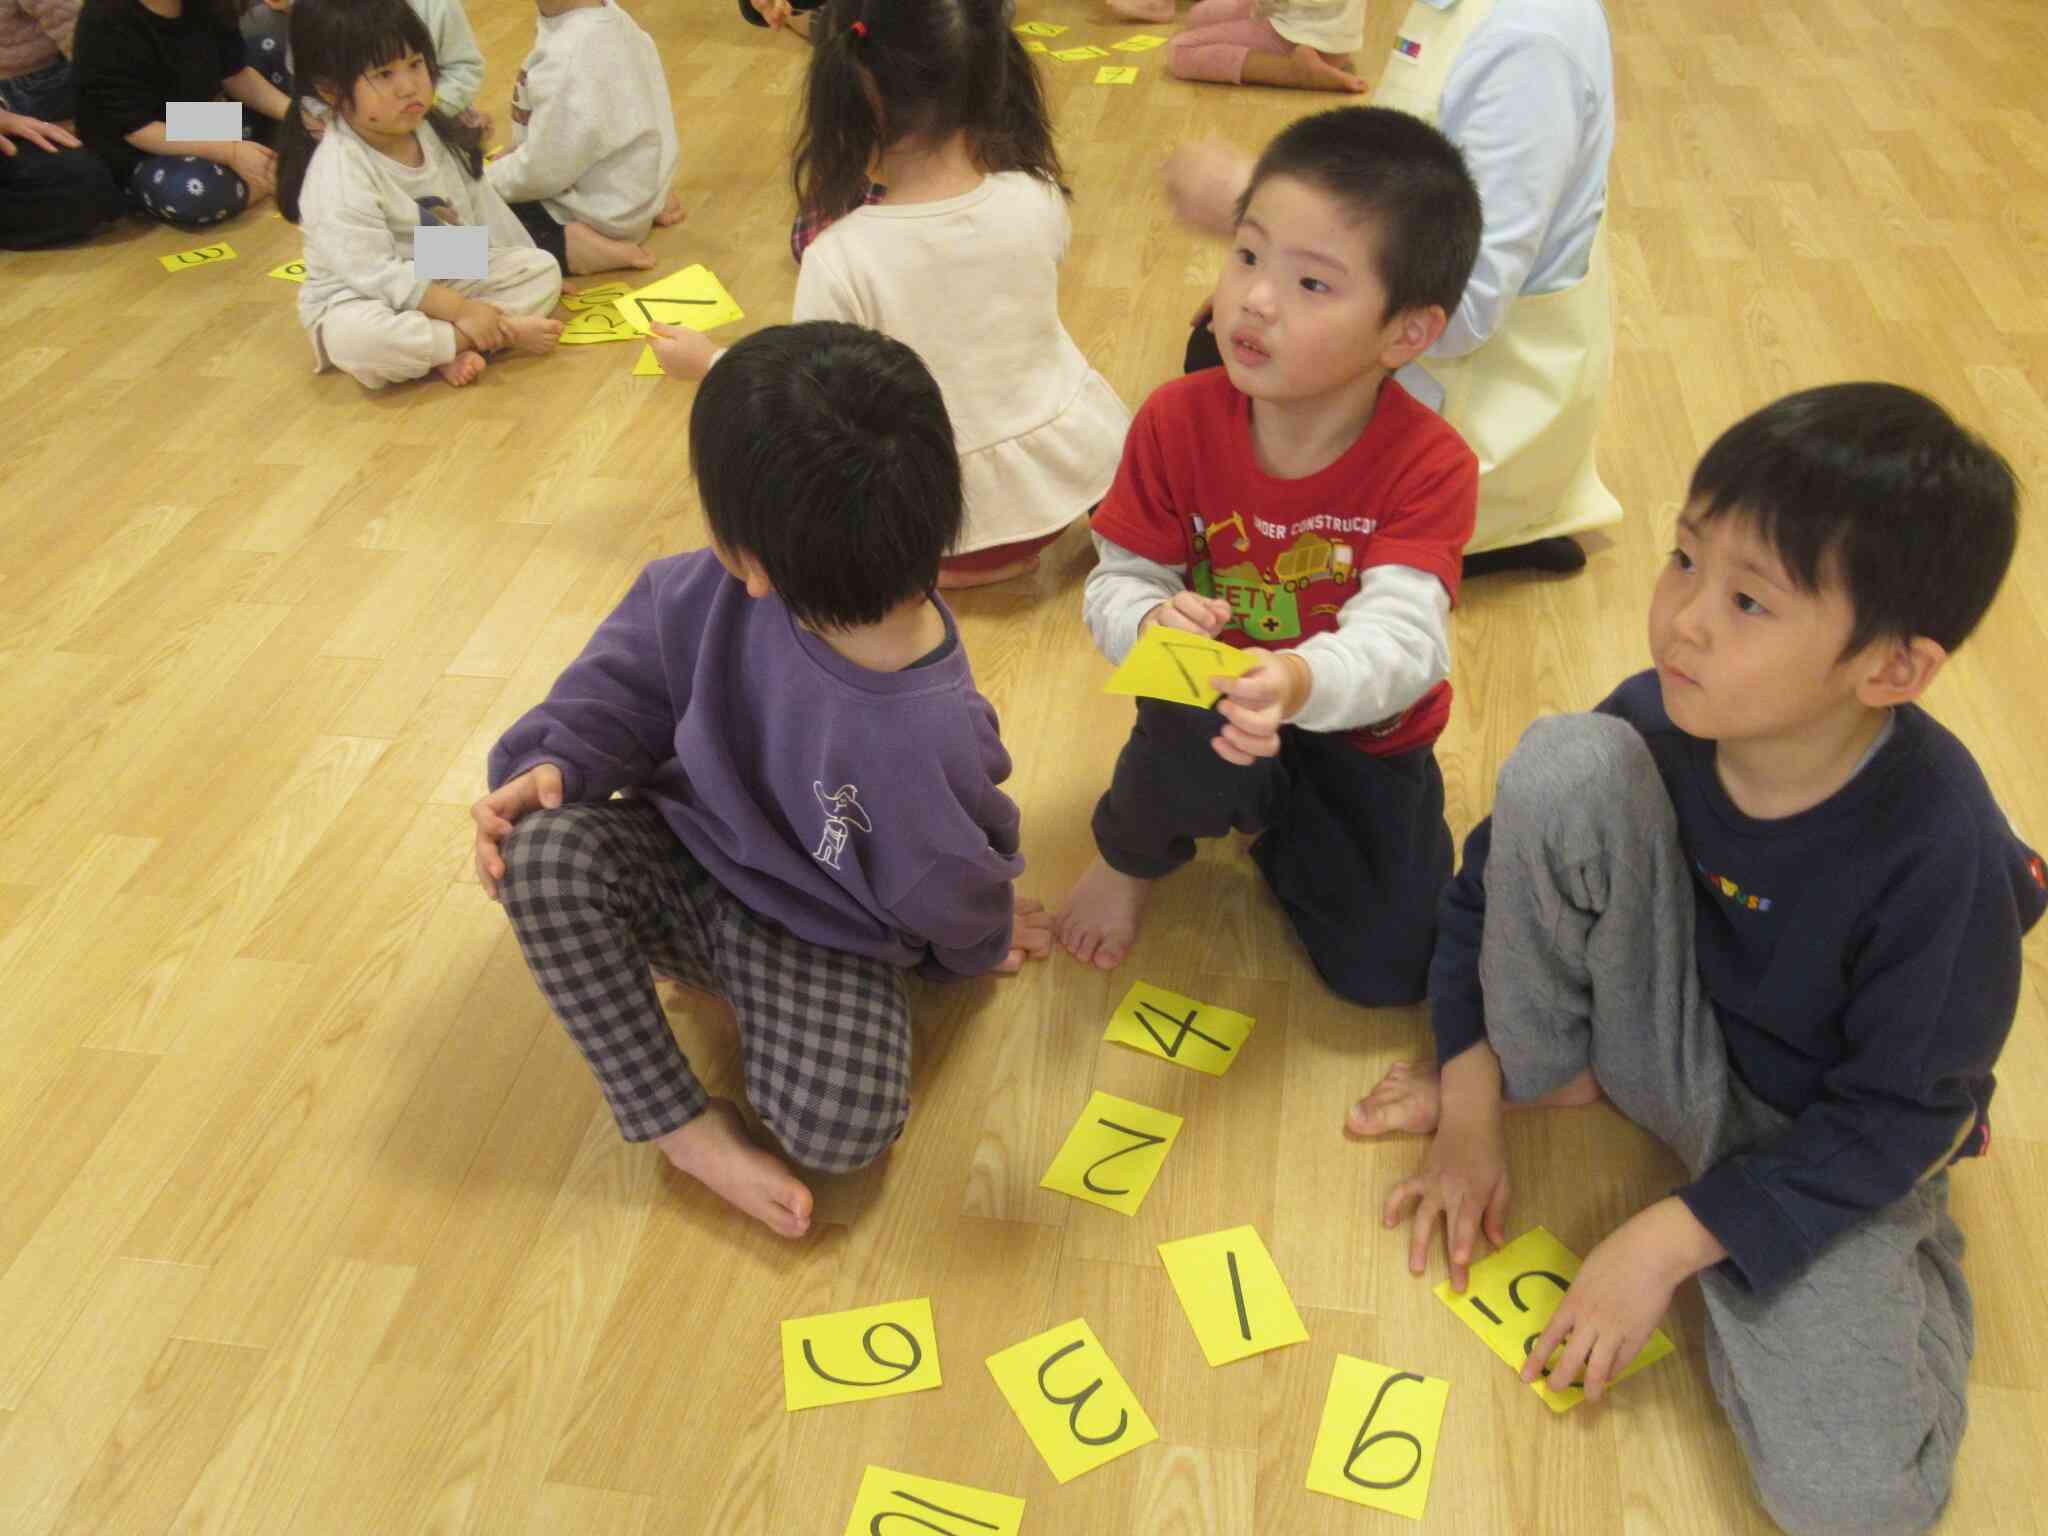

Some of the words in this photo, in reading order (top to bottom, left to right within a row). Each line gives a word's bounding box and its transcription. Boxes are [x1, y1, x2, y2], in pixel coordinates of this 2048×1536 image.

[1133, 1000, 1231, 1058] 4
[1082, 1117, 1167, 1196] 2
[1227, 1251, 1252, 1341] 1
[1038, 1340, 1128, 1446] 3
